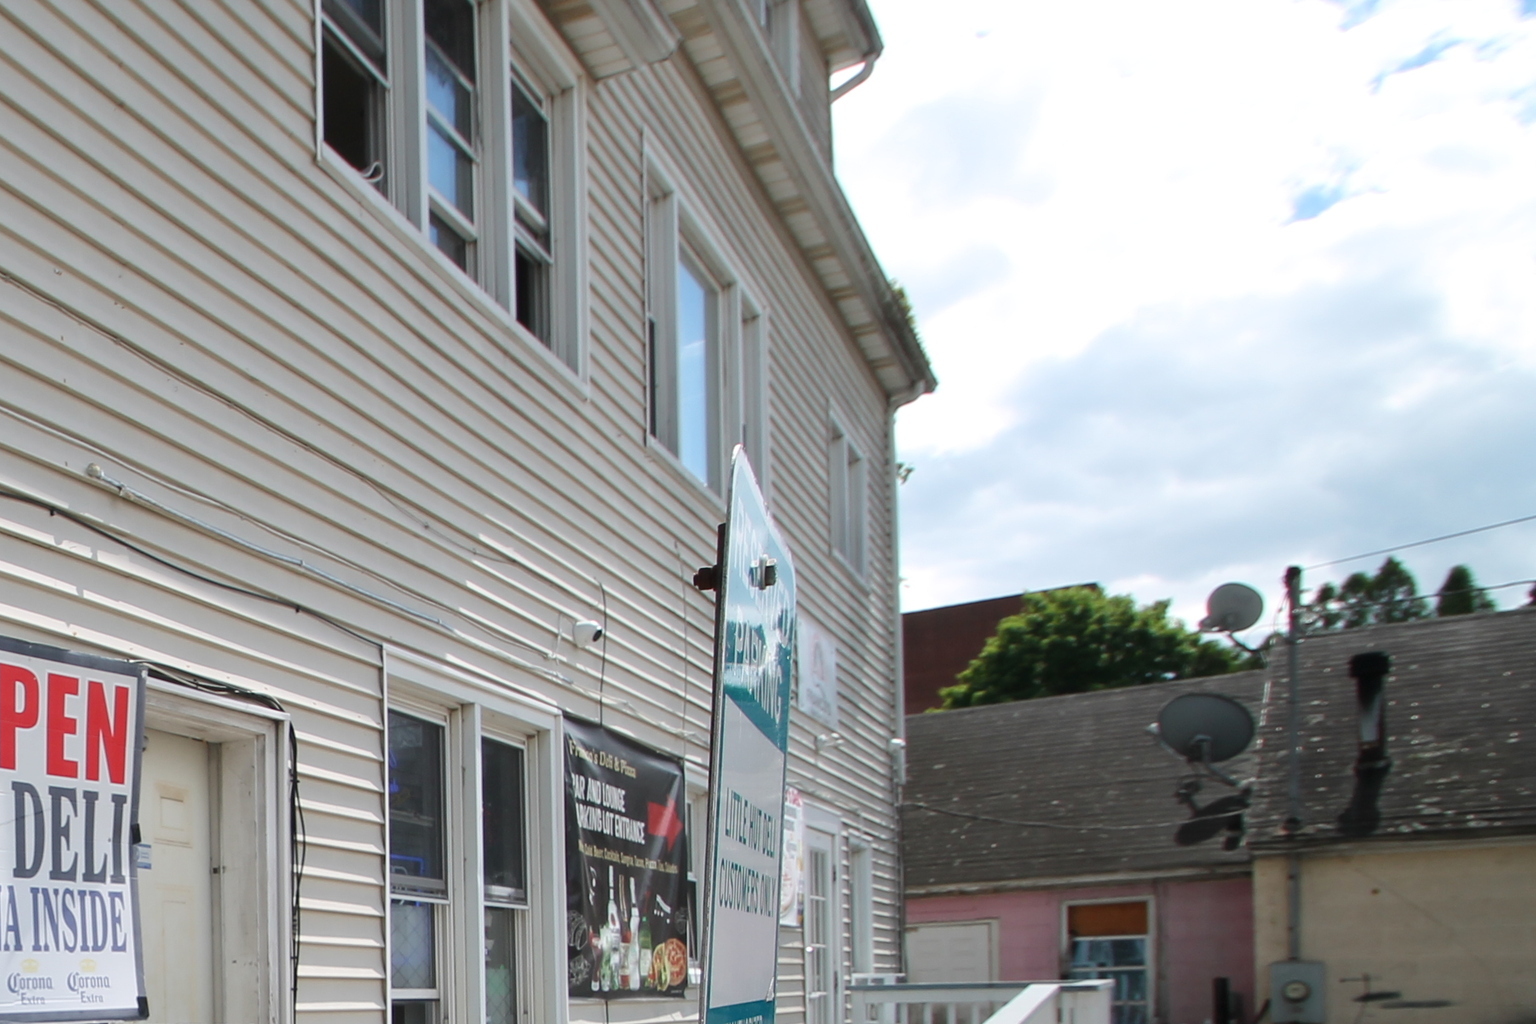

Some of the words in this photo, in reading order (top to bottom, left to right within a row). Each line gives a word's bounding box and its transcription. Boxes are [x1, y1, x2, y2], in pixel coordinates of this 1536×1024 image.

[734, 604, 783, 725] PARKING
[587, 778, 601, 804] AND
[602, 782, 625, 813] LOUNGE
[725, 787, 748, 845] LITTLE
[11, 780, 128, 885] DELI
[576, 803, 602, 832] RKING
[603, 810, 614, 836] LOT
[615, 814, 645, 845] ENTRANCE
[719, 858, 758, 914] CUSTOMERS
[30, 886, 128, 953] INSIDE
[8, 972, 53, 995] Corona
[67, 972, 111, 994] Corona
[21, 993, 45, 1005] Extra
[81, 991, 104, 1003] Extra
